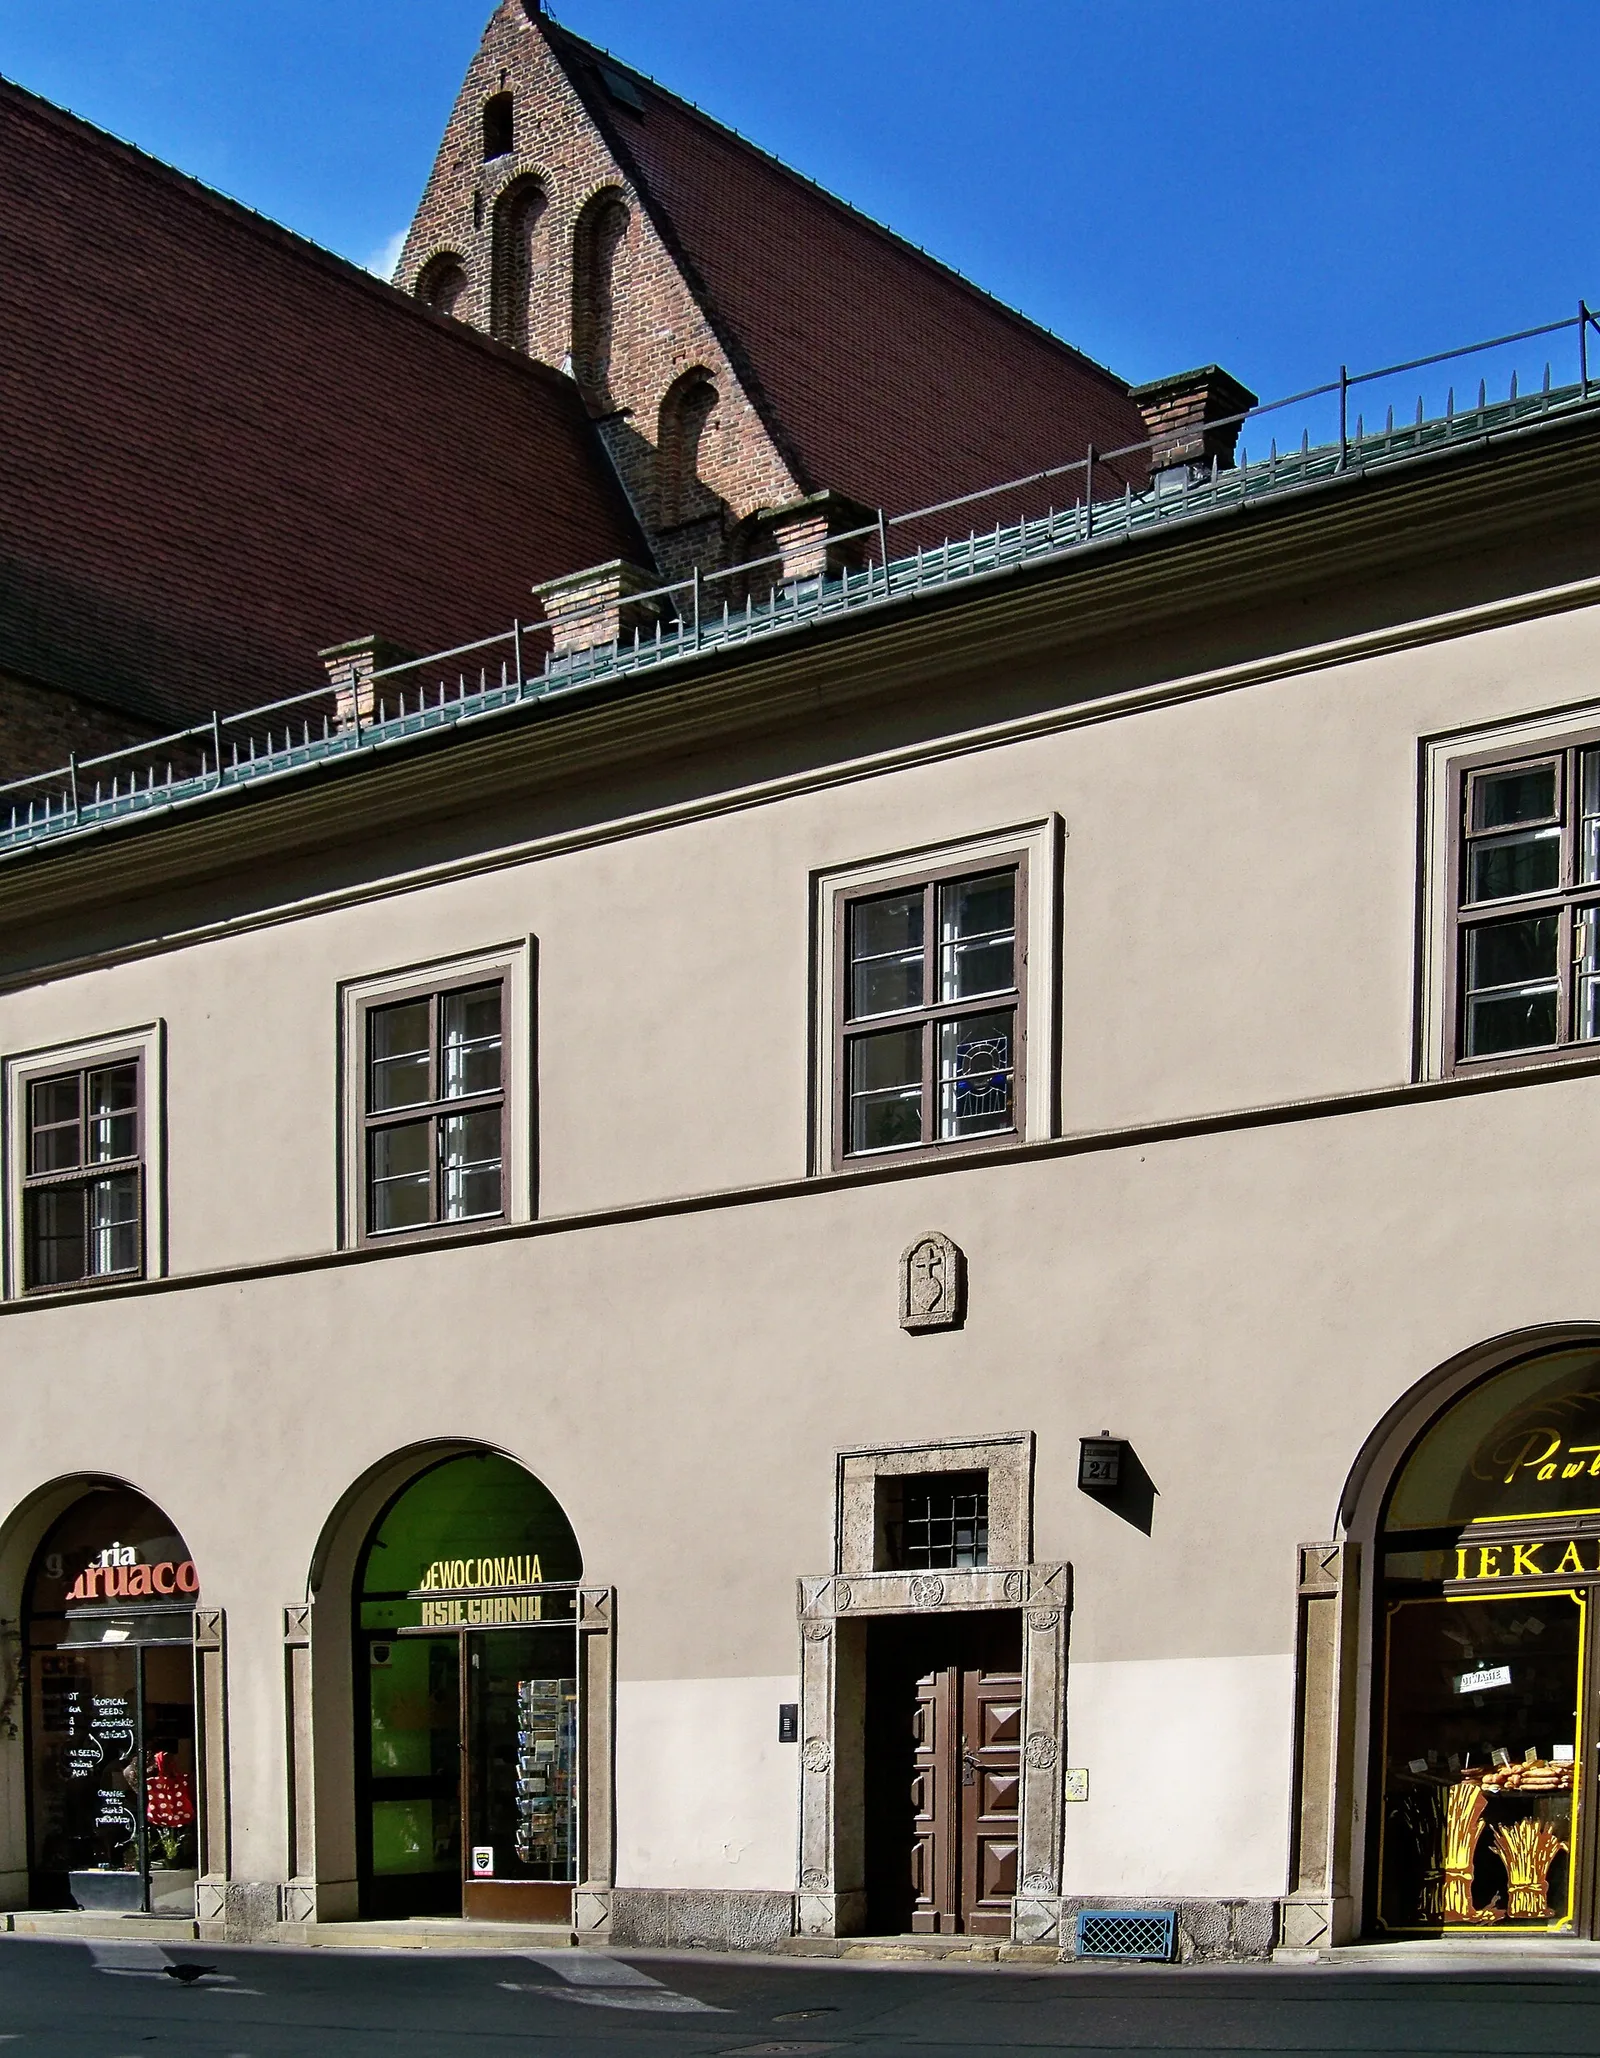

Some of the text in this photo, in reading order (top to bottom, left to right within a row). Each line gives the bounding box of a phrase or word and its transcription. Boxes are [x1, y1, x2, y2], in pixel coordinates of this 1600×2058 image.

[1089, 1461, 1111, 1478] 24
[420, 1554, 542, 1590] DEWOCJONALIA
[1461, 1670, 1501, 1686] OTWARTE
[91, 1694, 128, 1707] TROPICAL
[99, 1708, 124, 1716] SEEDS
[78, 1749, 101, 1758] SEEDS
